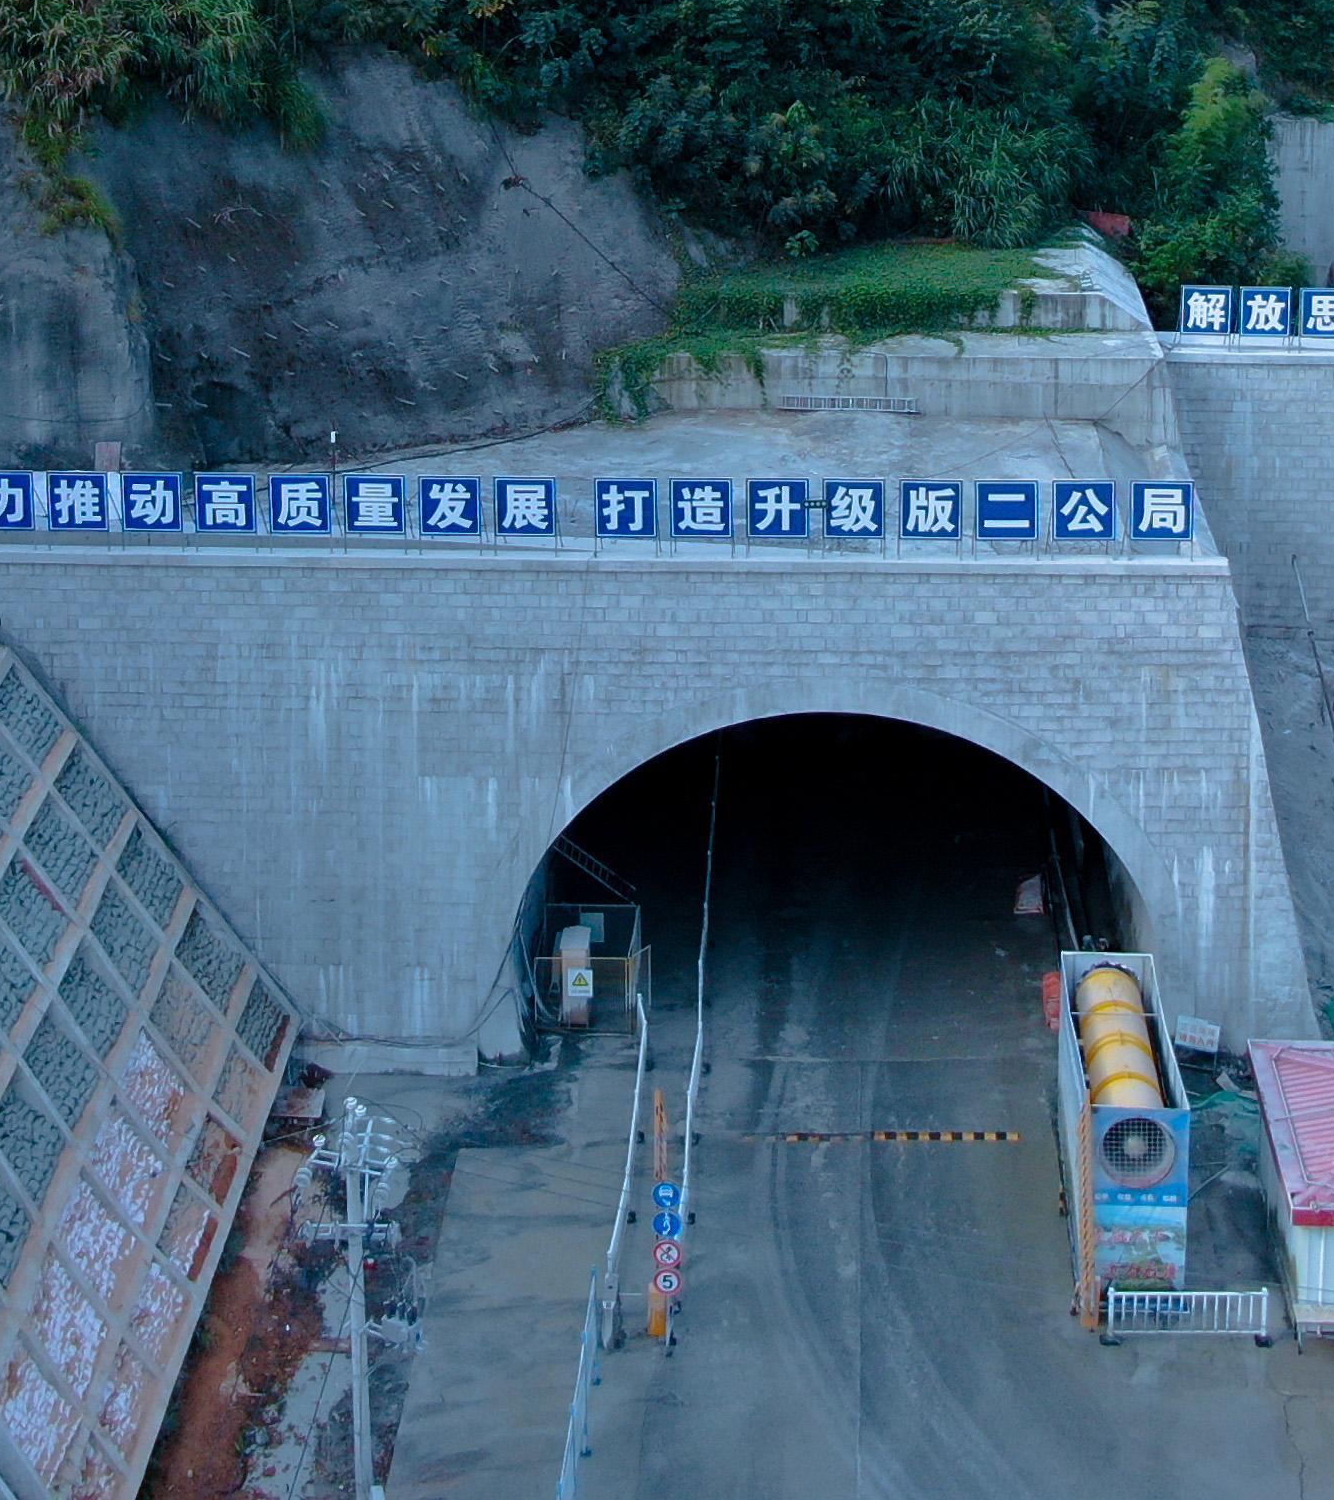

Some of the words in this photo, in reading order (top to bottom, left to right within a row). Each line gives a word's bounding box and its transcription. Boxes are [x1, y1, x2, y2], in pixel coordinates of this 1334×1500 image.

[602, 486, 1187, 534] 打造升级版二公局
[662, 1275, 673, 1289] 5
